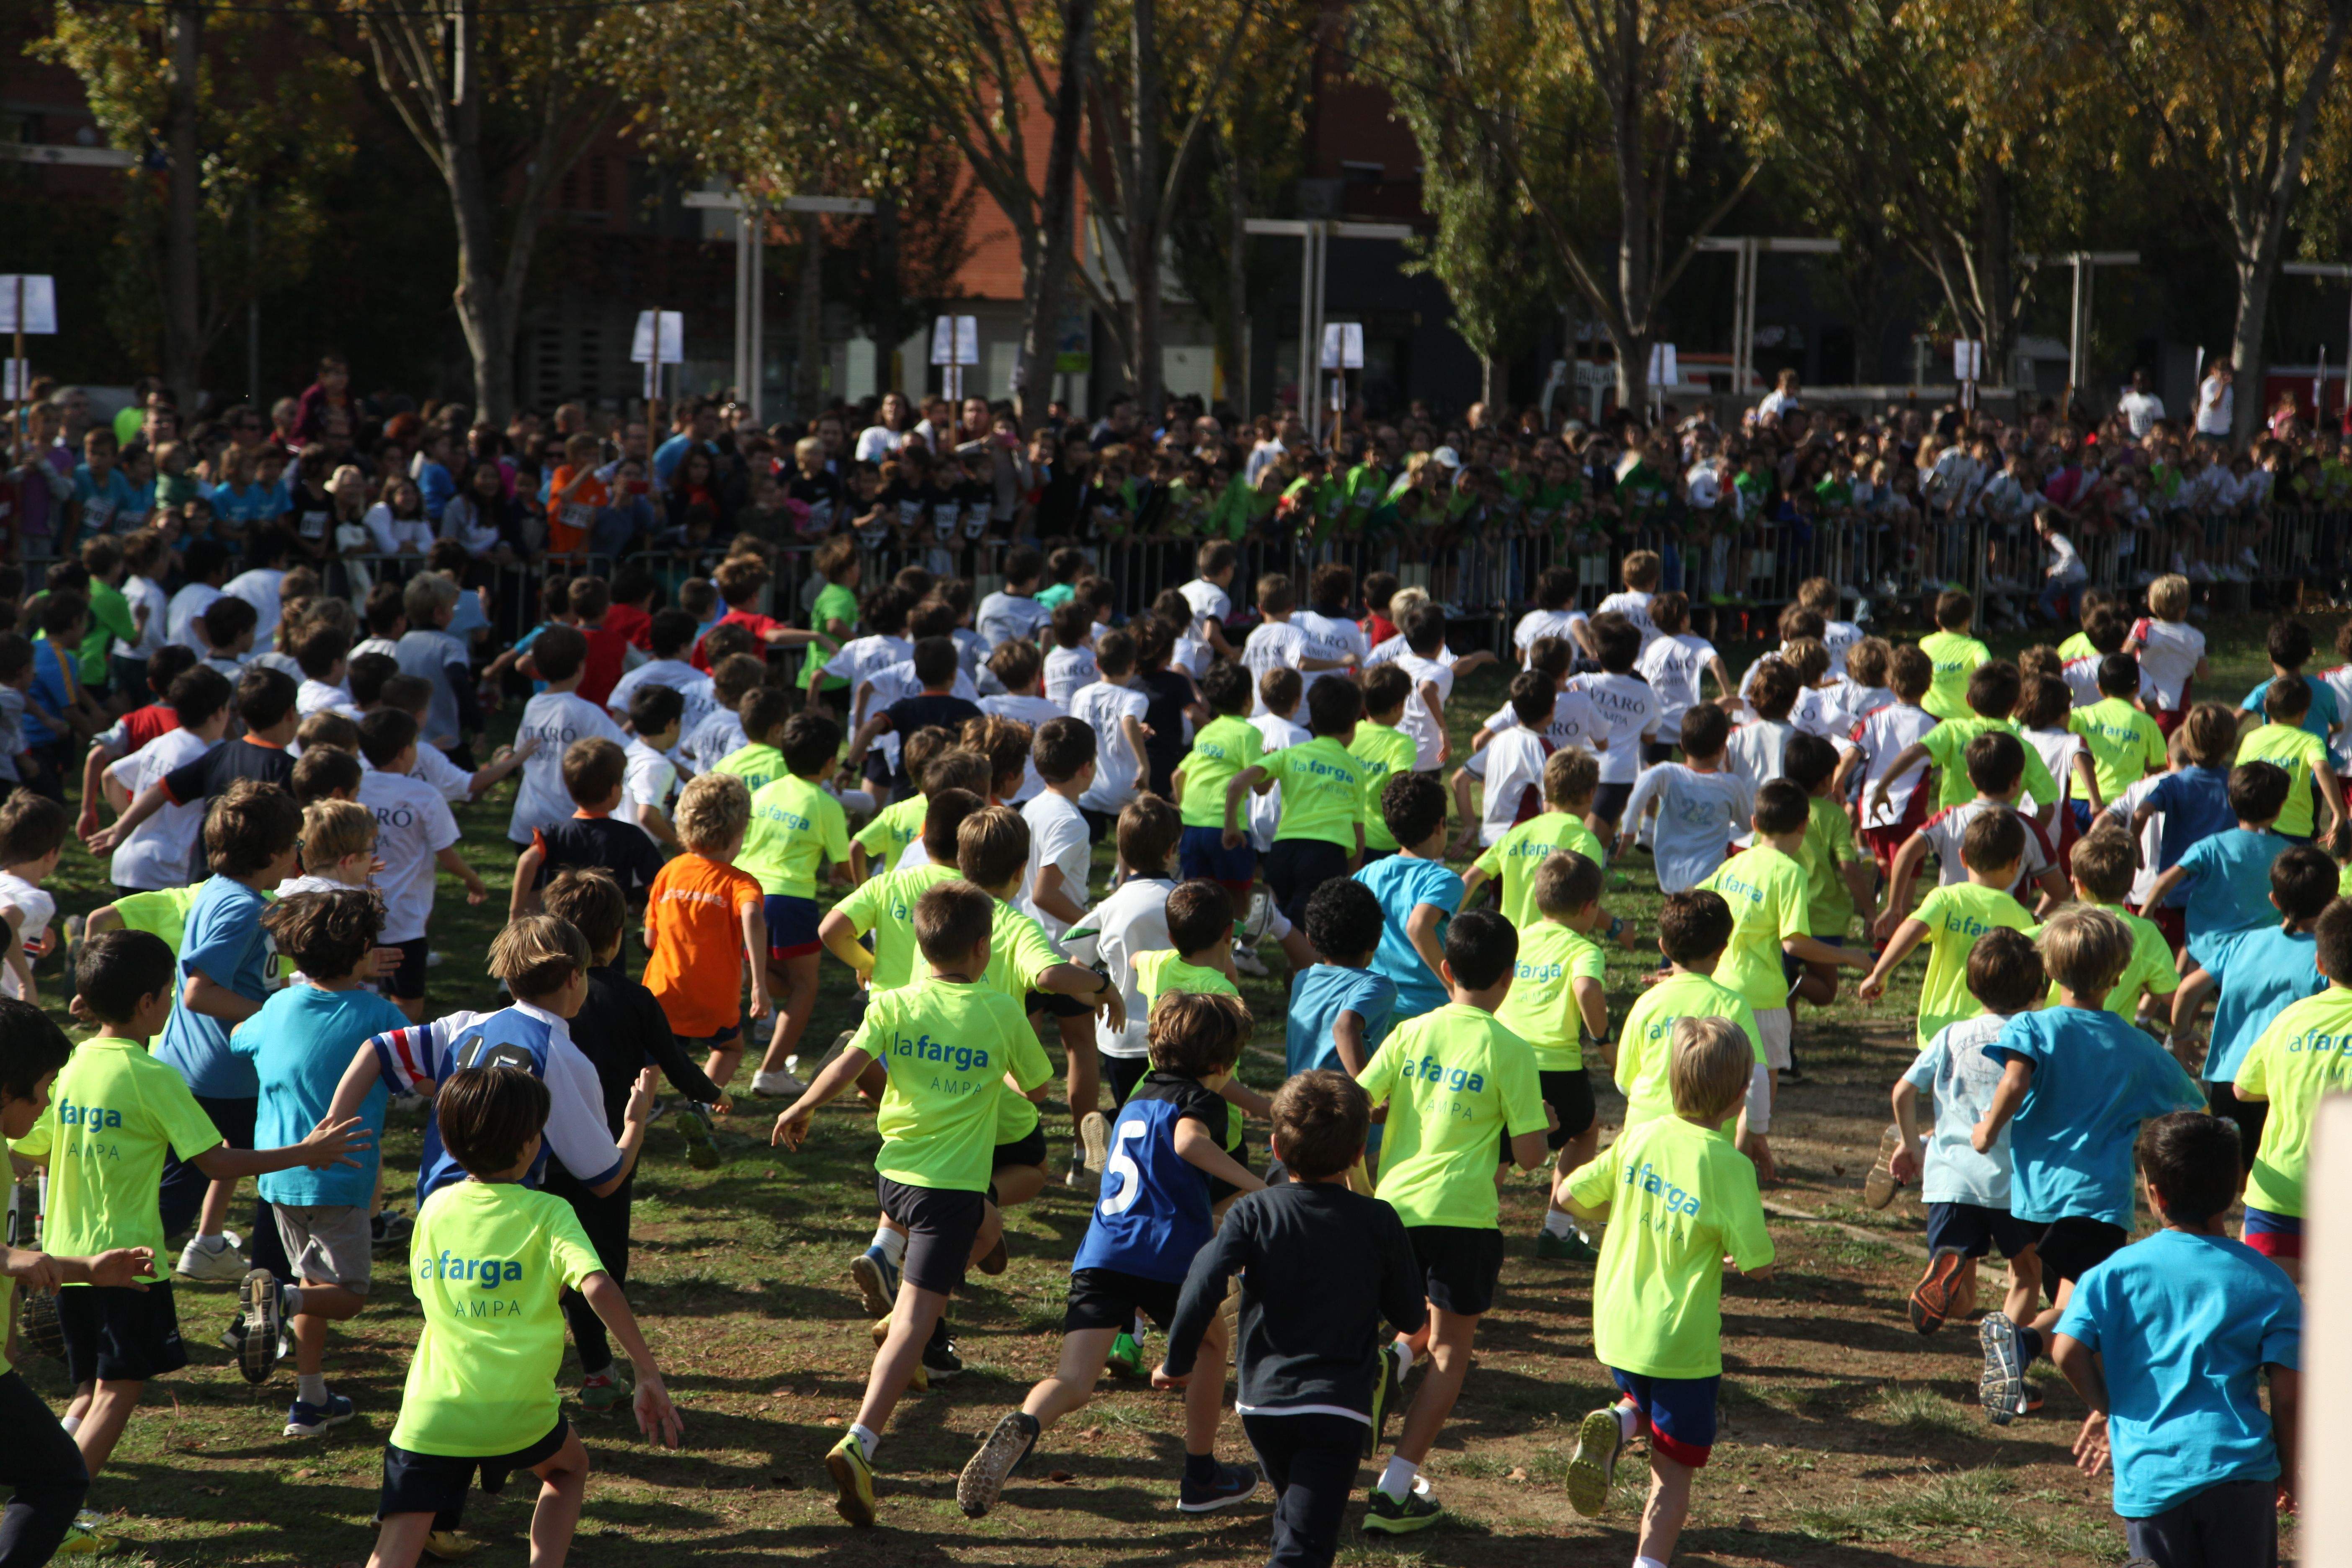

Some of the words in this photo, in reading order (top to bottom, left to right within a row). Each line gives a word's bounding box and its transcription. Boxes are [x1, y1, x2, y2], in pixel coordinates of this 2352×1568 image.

[1590, 687, 1645, 715] VIARÓ
[2098, 723, 2141, 743] farga
[1293, 759, 1306, 772] la
[1310, 759, 1354, 784] farga
[1317, 782, 1348, 797] AMPA
[769, 803, 809, 831] farga
[1679, 797, 1716, 826] 22
[890, 897, 907, 920] la
[1944, 911, 1961, 932] la
[893, 1032, 913, 1057] la
[916, 1035, 989, 1072] farga
[931, 1077, 982, 1096] AMPA
[1420, 1055, 1485, 1094] farga
[58, 1098, 121, 1133] farga
[1426, 1099, 1473, 1122] AMPA
[67, 1142, 120, 1161] AMPA
[1100, 1120, 1148, 1216] 5
[1638, 1163, 1701, 1217] farga
[418, 1252, 433, 1280] la
[439, 1250, 522, 1289] farga
[454, 1300, 521, 1318] AMPA
